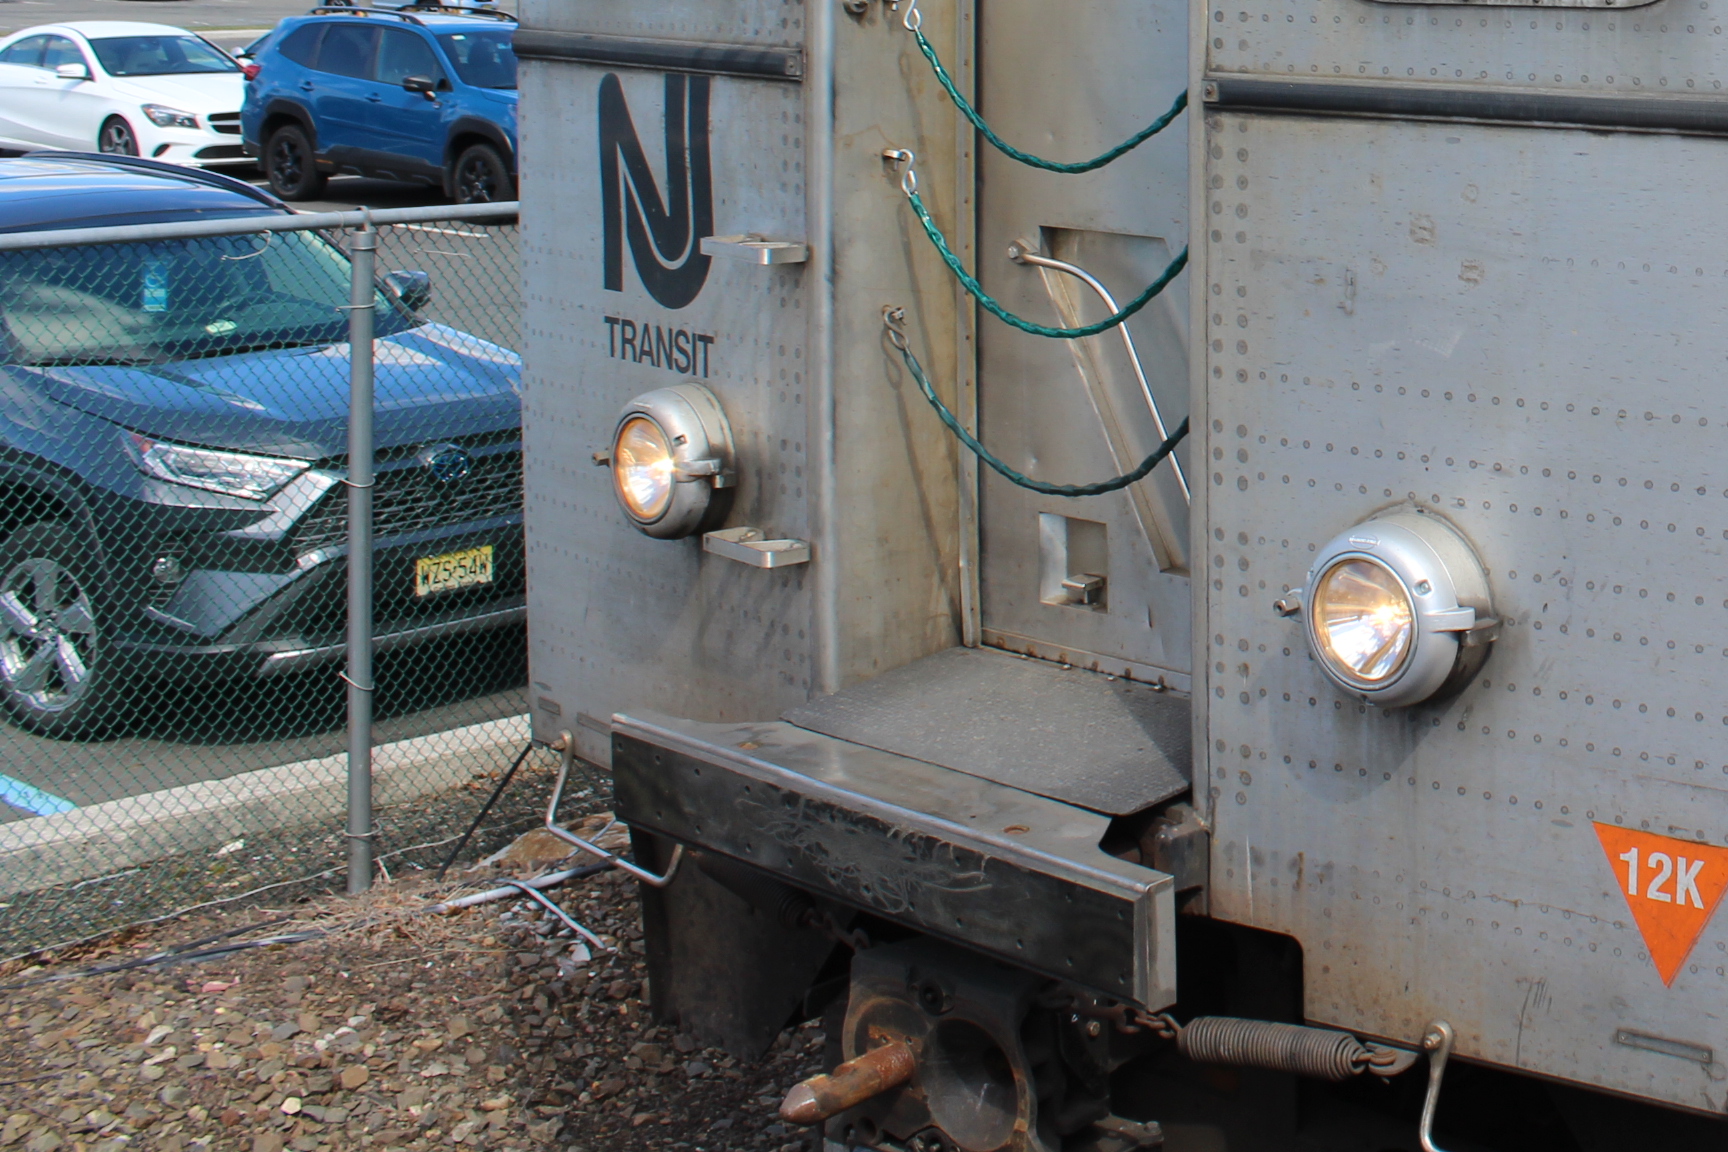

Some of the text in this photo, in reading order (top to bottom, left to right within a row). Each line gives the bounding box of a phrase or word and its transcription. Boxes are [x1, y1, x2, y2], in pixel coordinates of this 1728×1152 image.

[598, 73, 714, 309] NJ
[604, 315, 715, 379] TRANSIT
[1619, 846, 1705, 910] 12K
